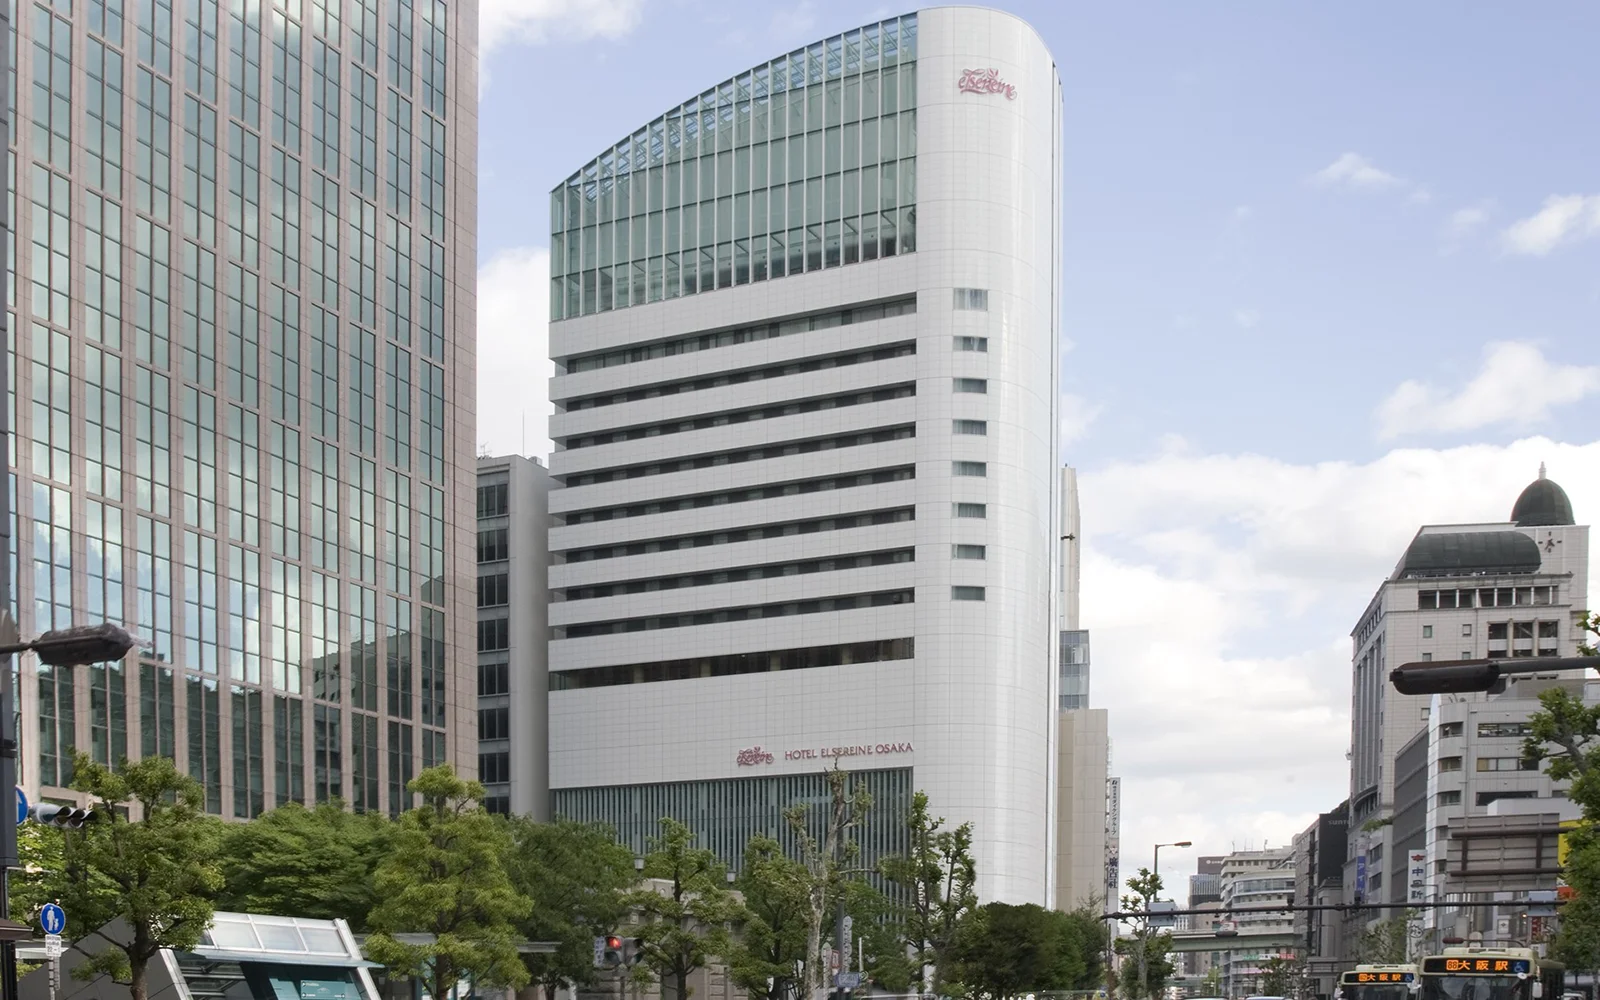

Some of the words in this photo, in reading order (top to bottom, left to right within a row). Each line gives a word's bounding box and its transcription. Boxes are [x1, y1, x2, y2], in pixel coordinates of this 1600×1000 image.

[785, 749, 817, 761] HOTEL
[821, 745, 873, 759] ELSEREINE
[875, 743, 913, 754] OSAKA
[1458, 960, 1509, 971] 大阪駅
[1367, 973, 1401, 982] 大阪駅
